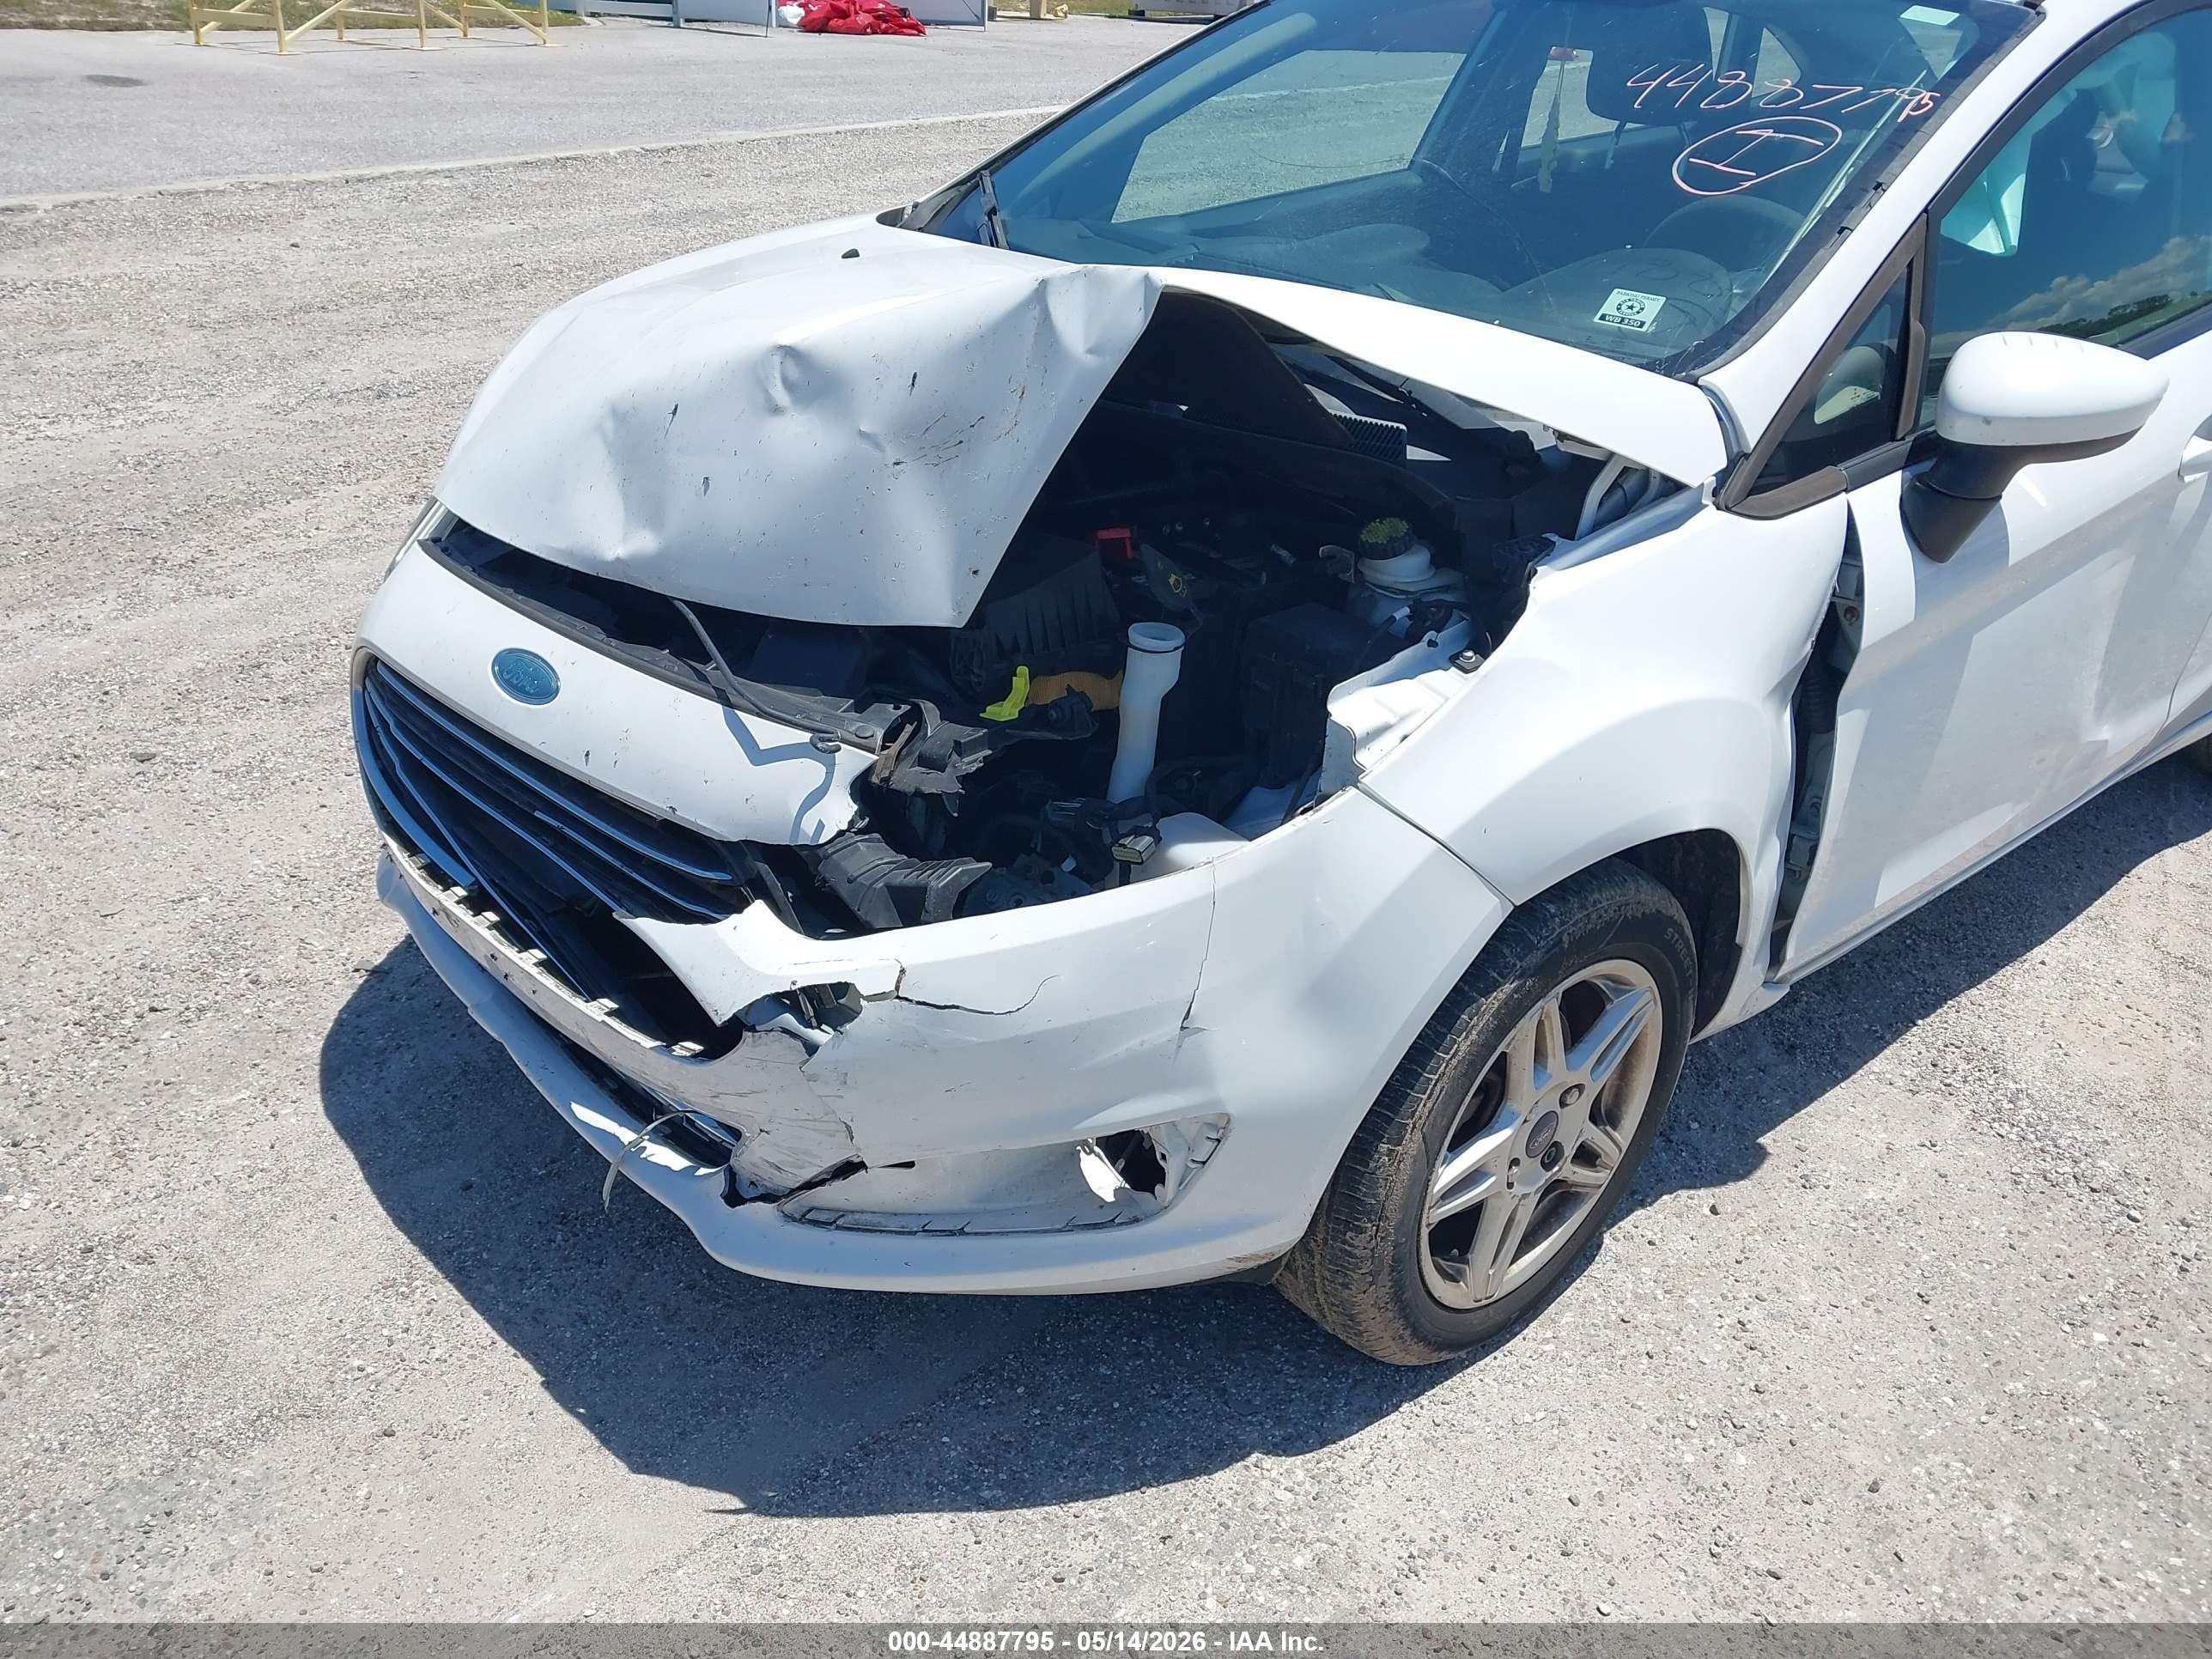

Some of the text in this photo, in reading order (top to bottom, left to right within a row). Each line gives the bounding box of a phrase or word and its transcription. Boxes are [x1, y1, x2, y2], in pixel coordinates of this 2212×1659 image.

[1626, 63, 1942, 124] 44887795
[1615, 290, 1661, 303] PARKING PERMIT
[1605, 314, 1641, 327] WB 350
[1664, 927, 1693, 976] STREET
